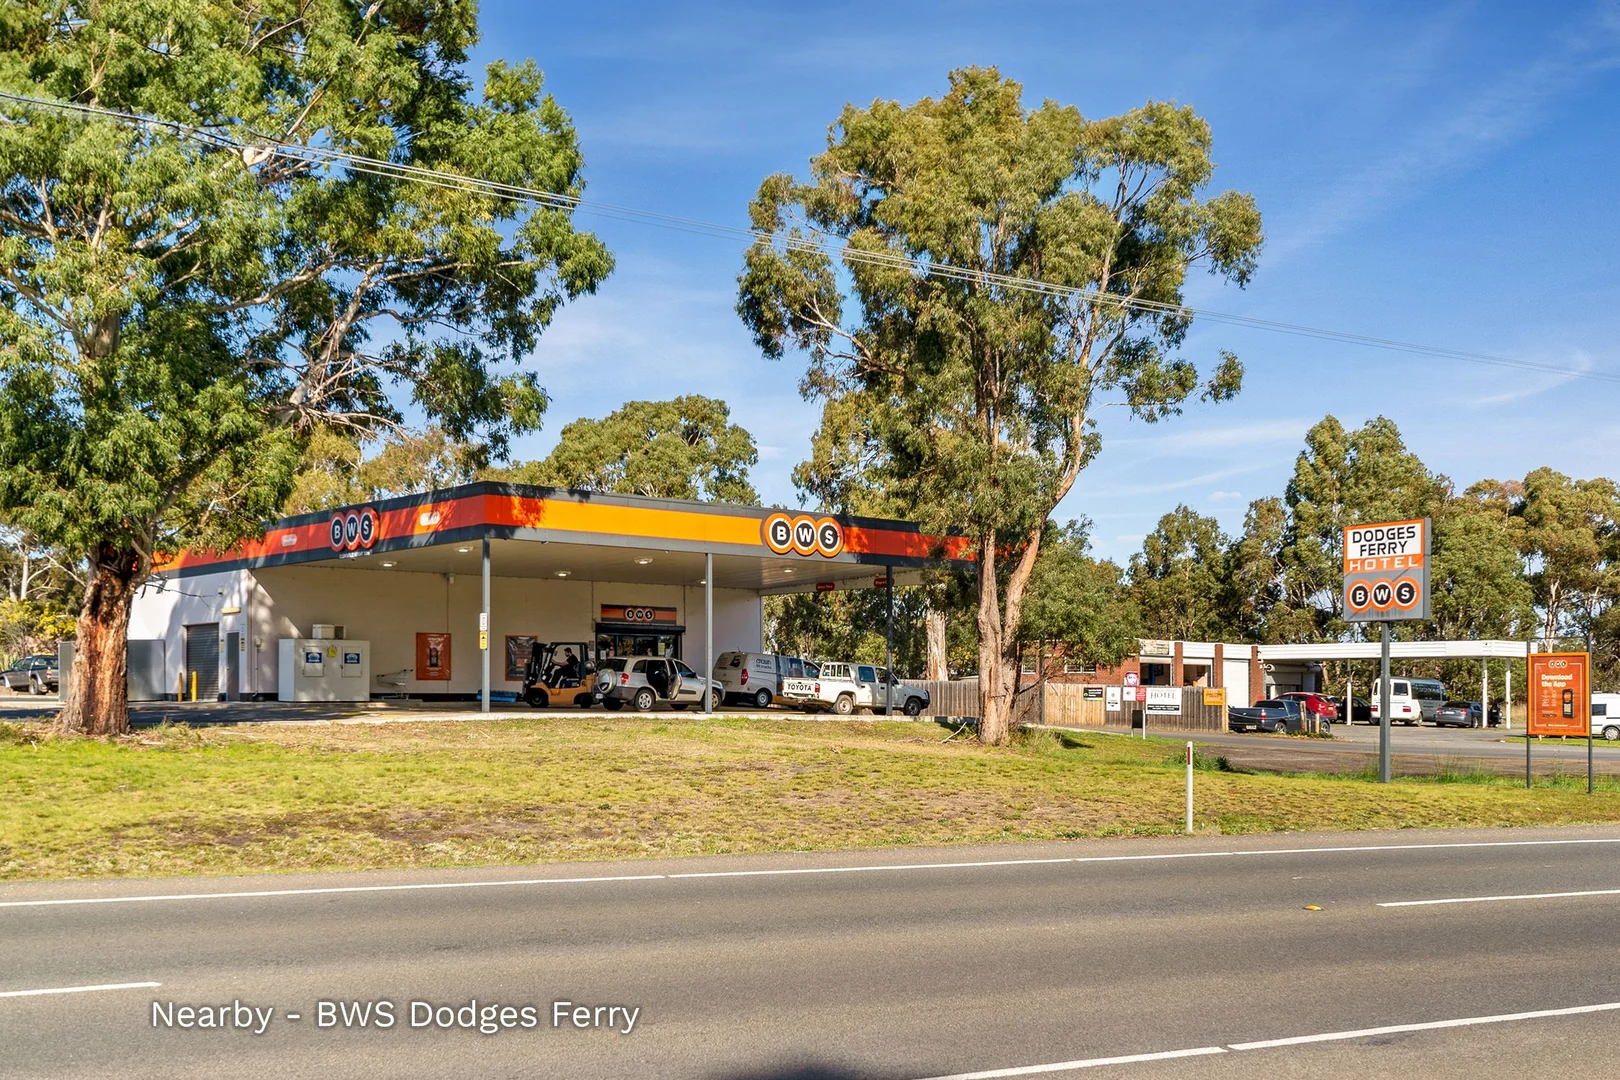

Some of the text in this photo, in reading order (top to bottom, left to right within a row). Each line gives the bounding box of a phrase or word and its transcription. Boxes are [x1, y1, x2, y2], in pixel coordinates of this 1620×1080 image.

[1352, 526, 1416, 544] DODGES
[1360, 541, 1408, 557] FERRY
[1349, 556, 1419, 572] HOTEL
[1541, 673, 1573, 681] Download
[787, 683, 812, 692] TOYOTA
